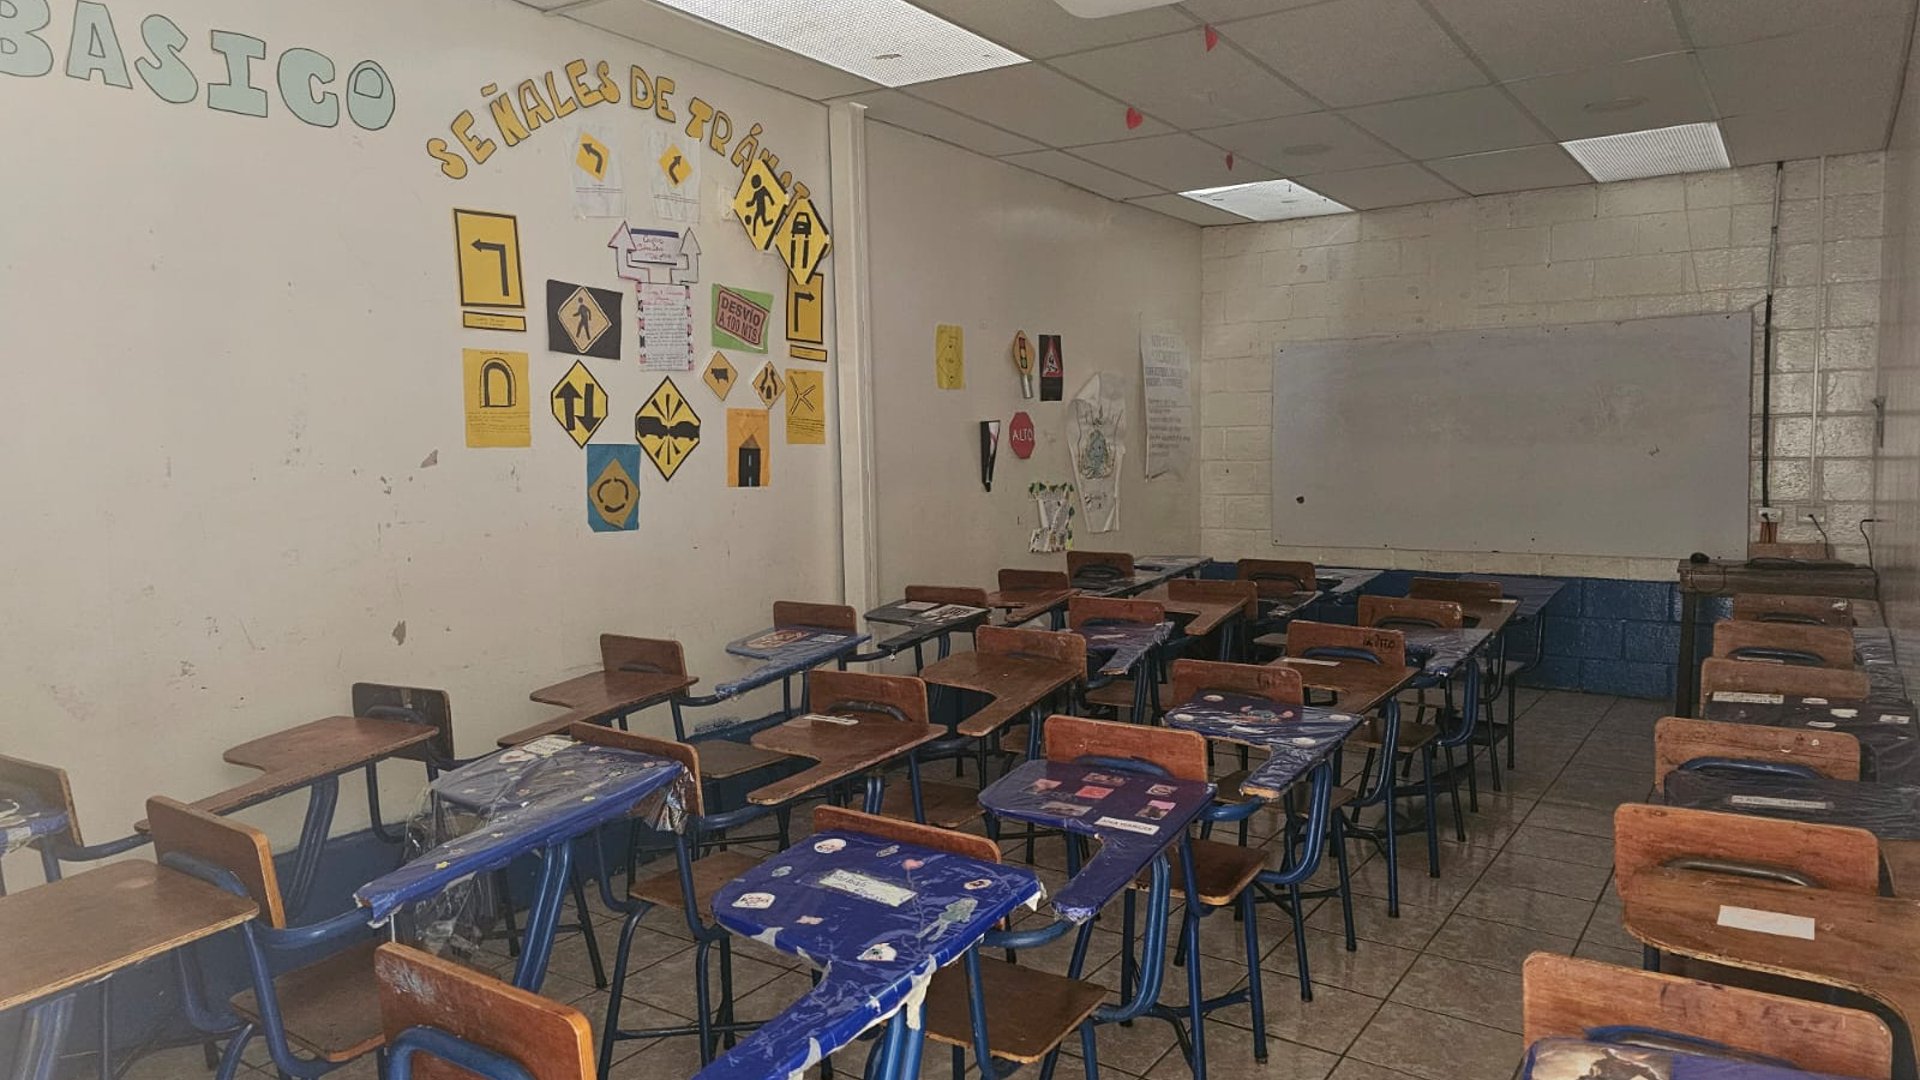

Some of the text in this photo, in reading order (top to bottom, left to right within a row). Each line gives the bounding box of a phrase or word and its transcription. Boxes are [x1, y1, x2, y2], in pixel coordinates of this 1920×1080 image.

[0, 0, 395, 131] BASICO
[427, 58, 621, 180] SEÑALES
[630, 64, 676, 123] DE
[719, 311, 725, 327] A
[726, 314, 740, 332] 100
[1012, 427, 1034, 442] ALTO
